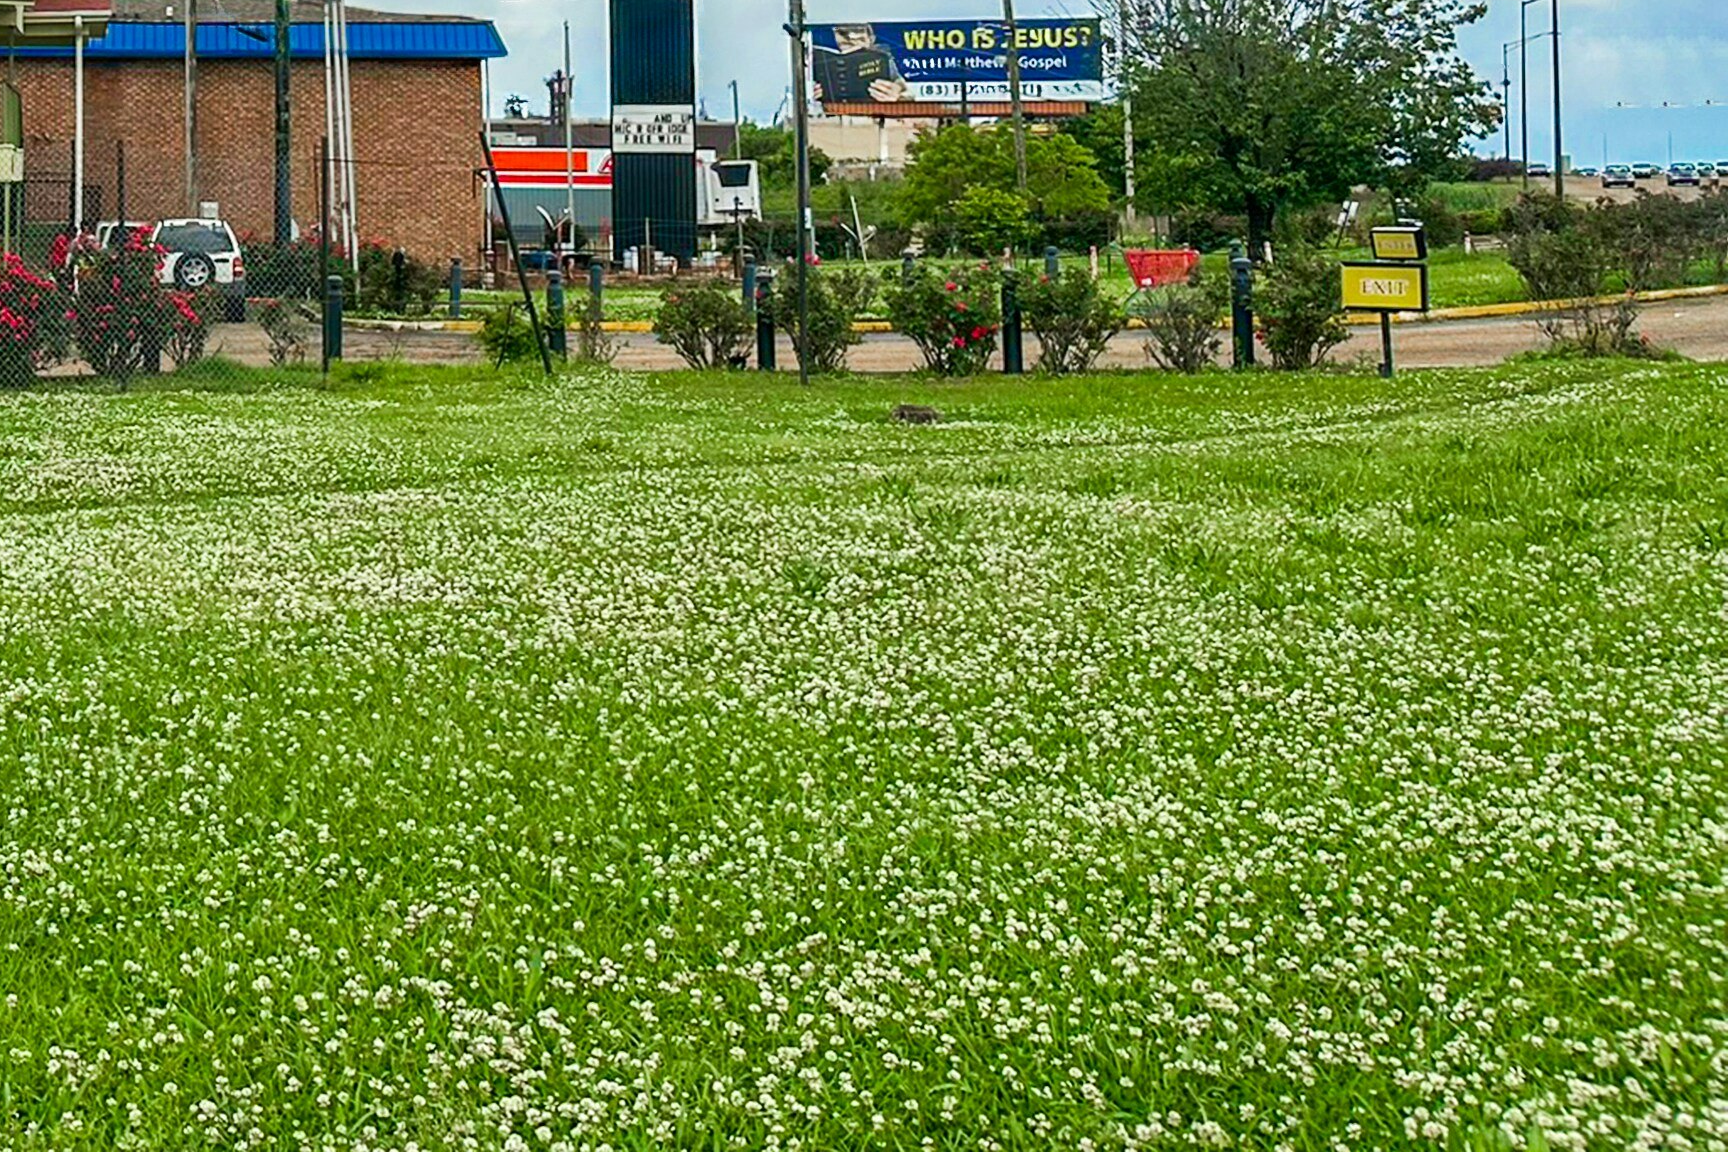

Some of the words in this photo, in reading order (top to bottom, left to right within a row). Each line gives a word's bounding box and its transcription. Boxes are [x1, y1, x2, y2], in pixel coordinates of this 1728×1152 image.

[903, 29, 966, 50] WHO
[972, 28, 996, 49] IS
[1018, 55, 1068, 70] Gospel
[654, 114, 672, 123] AND
[1362, 280, 1408, 295] EXIT
